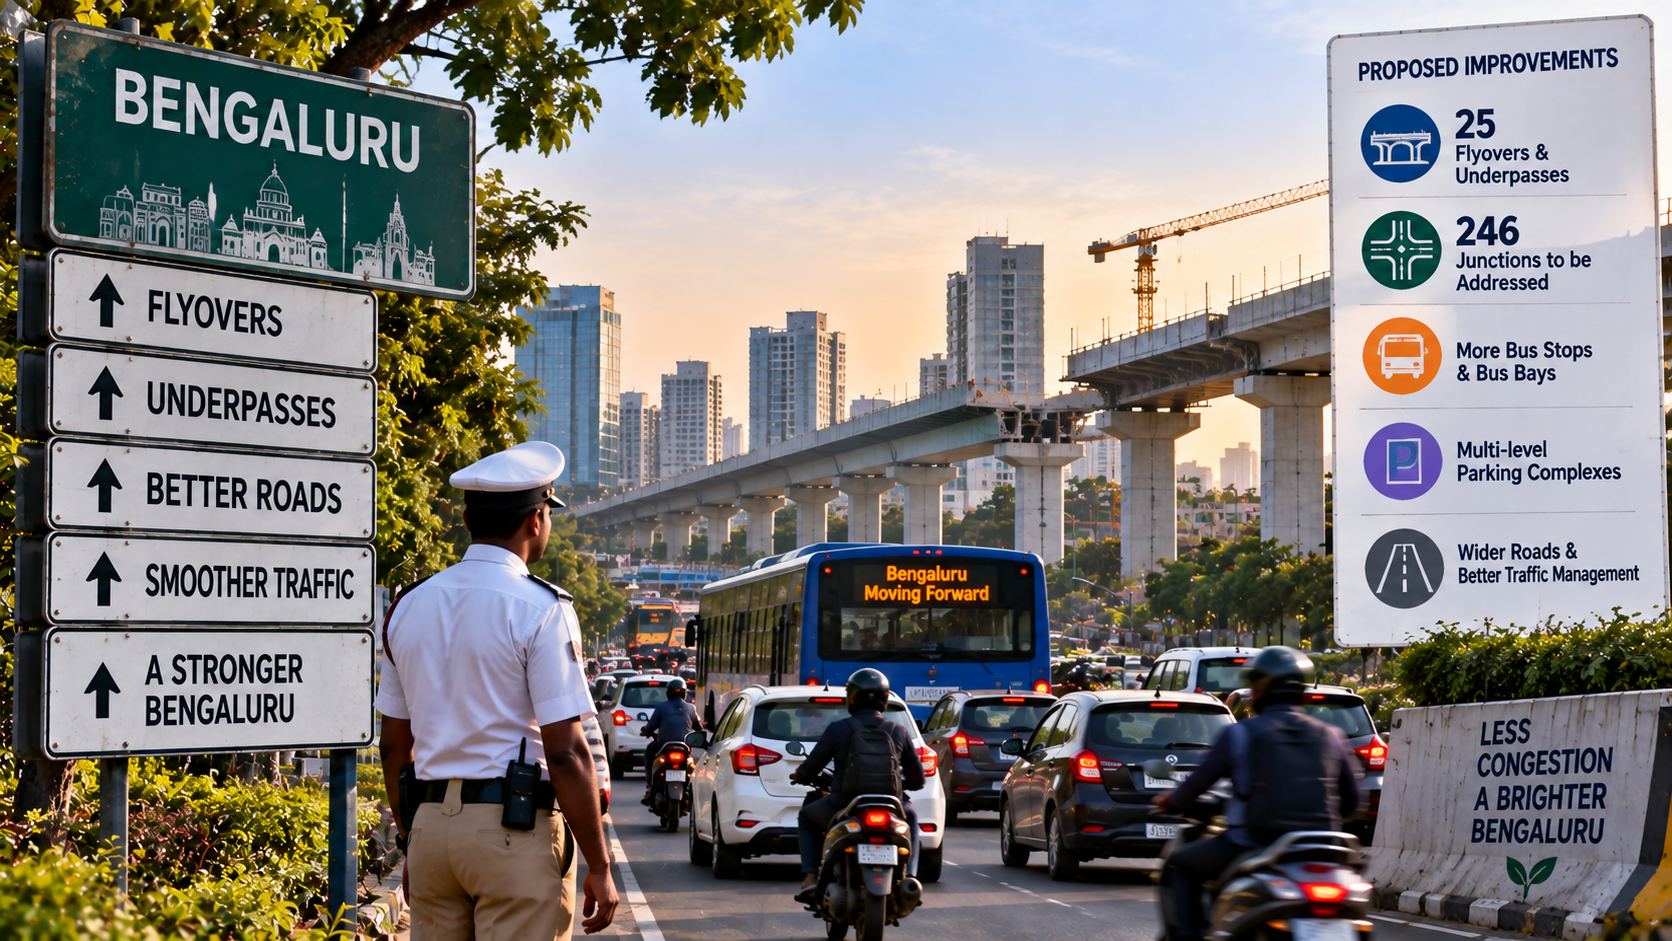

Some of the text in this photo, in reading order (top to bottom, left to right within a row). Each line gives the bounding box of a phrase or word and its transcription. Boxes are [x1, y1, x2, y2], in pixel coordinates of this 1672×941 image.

[1359, 48, 1618, 81] PROPOSED IMPROVEMENTS
[115, 69, 420, 173] BENGALURU
[1456, 109, 1495, 139] 25
[1456, 144, 1548, 165] Flyovers &
[1456, 167, 1569, 187] Underpasses
[1457, 216, 1519, 246] 246
[1456, 251, 1591, 268] Junctions to be
[1456, 273, 1548, 290] Addressed
[148, 289, 283, 338] FLYOVERS
[1457, 342, 1592, 362] More Bus Stops
[1457, 364, 1556, 385] & Bus Bays
[147, 381, 336, 429] UNDERPASSES
[1458, 440, 1547, 458] Multi-level
[1458, 463, 1621, 485] Parking Complexes
[147, 472, 341, 514] BETTER ROADS
[1458, 542, 1577, 560] Wider Roads &
[146, 564, 354, 599] SMOOTHER TRAFFIC
[886, 565, 967, 584] Bengaluru
[1459, 565, 1639, 585] Better Traffic Management
[864, 584, 989, 605] Moving Forward
[145, 654, 303, 685] A STRONGER
[146, 694, 294, 726] BENGALURU
[1481, 718, 1531, 746] LESS
[1478, 747, 1613, 777] CONGESTION
[1474, 783, 1606, 810] A BRIGHTER
[1471, 818, 1604, 844] BENGALURU
